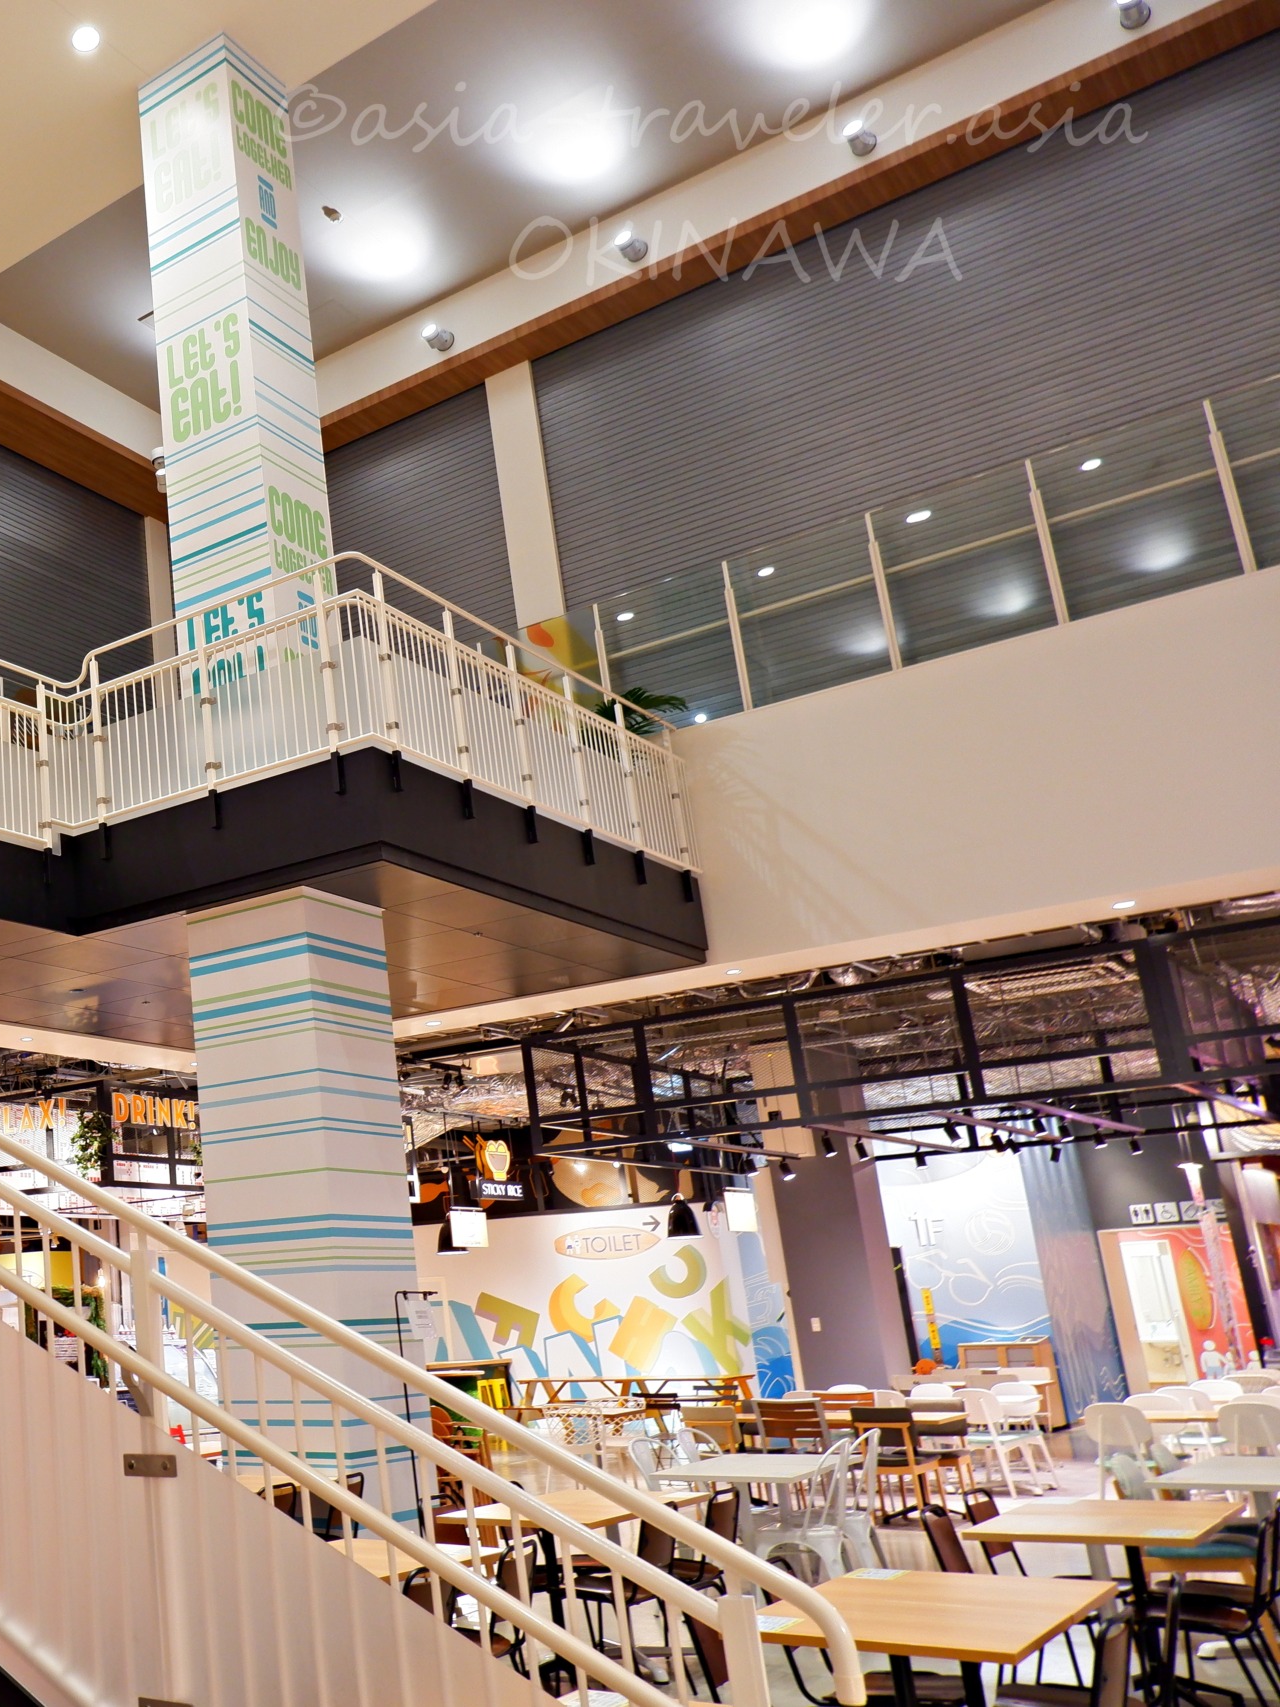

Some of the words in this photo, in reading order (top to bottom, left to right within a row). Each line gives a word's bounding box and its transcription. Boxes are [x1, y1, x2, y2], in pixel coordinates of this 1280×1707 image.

[231, 80, 287, 159] COME
[153, 134, 222, 214] EAT!
[236, 124, 292, 191] TOGETHER
[259, 185, 277, 220] AND
[245, 217, 302, 291] ENJOY
[166, 312, 240, 390] LET'S
[170, 359, 242, 443] EAT!
[268, 485, 328, 560] COME
[112, 1092, 196, 1130] DRINK!
[482, 1183, 506, 1196] STICKY
[507, 1184, 524, 1197] RICE
[582, 1234, 642, 1254] TOILET
